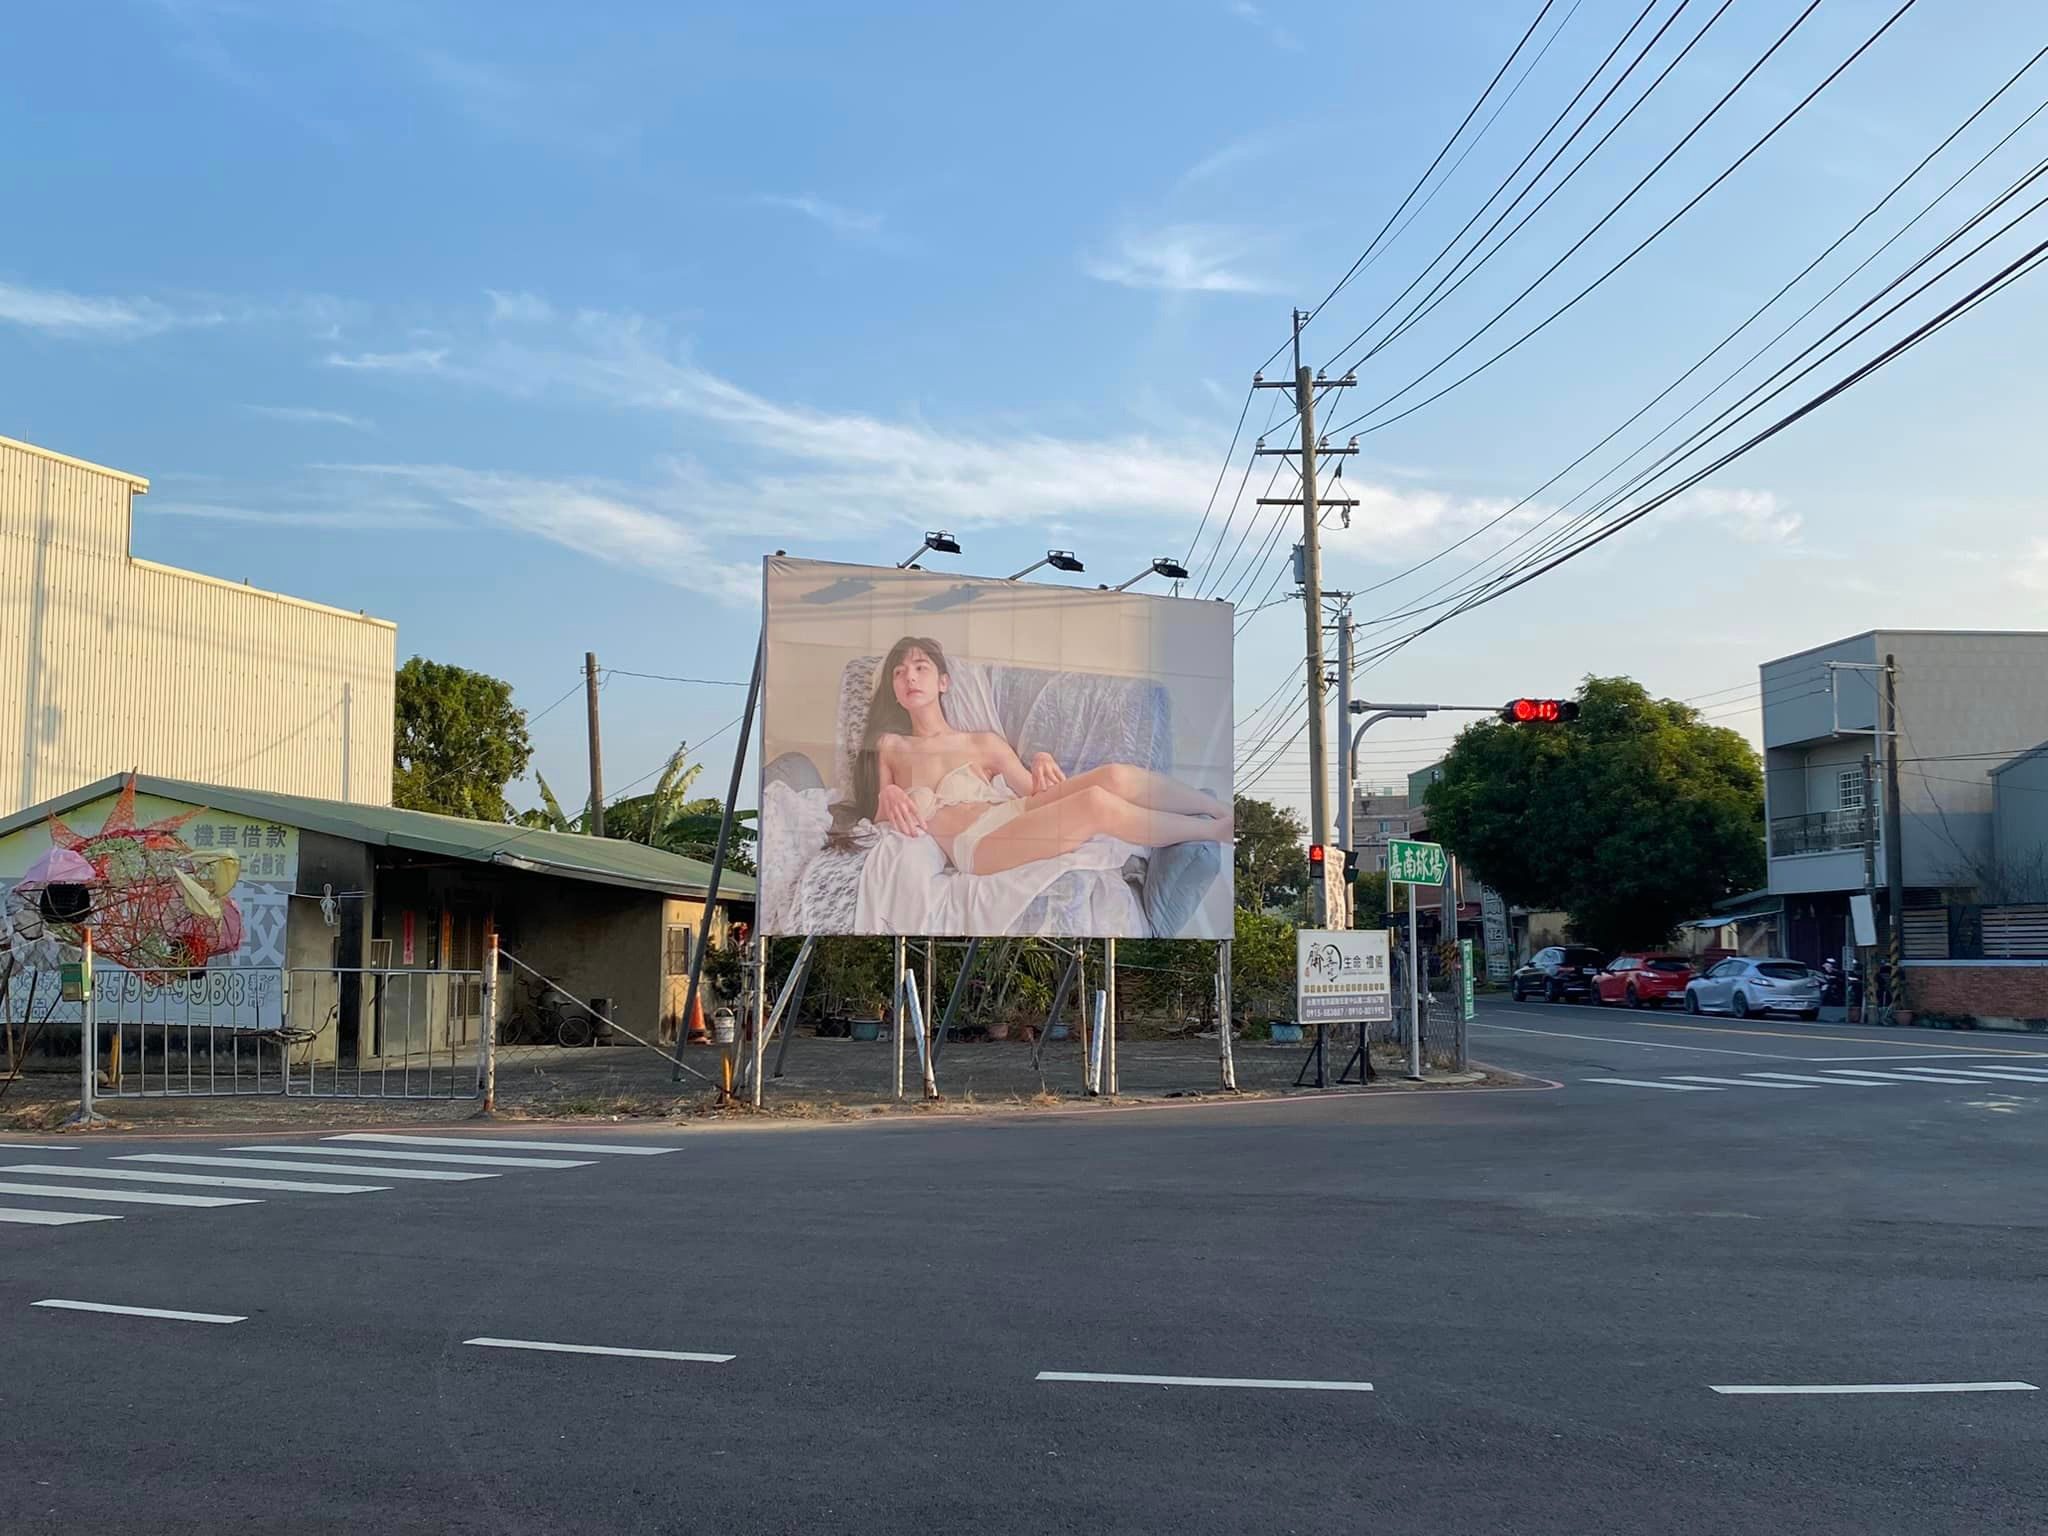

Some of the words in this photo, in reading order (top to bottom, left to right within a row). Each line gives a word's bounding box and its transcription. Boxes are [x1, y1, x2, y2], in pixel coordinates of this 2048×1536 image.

[194, 824, 287, 848] 機車借款
[1391, 843, 1443, 882] 嘉南球場
